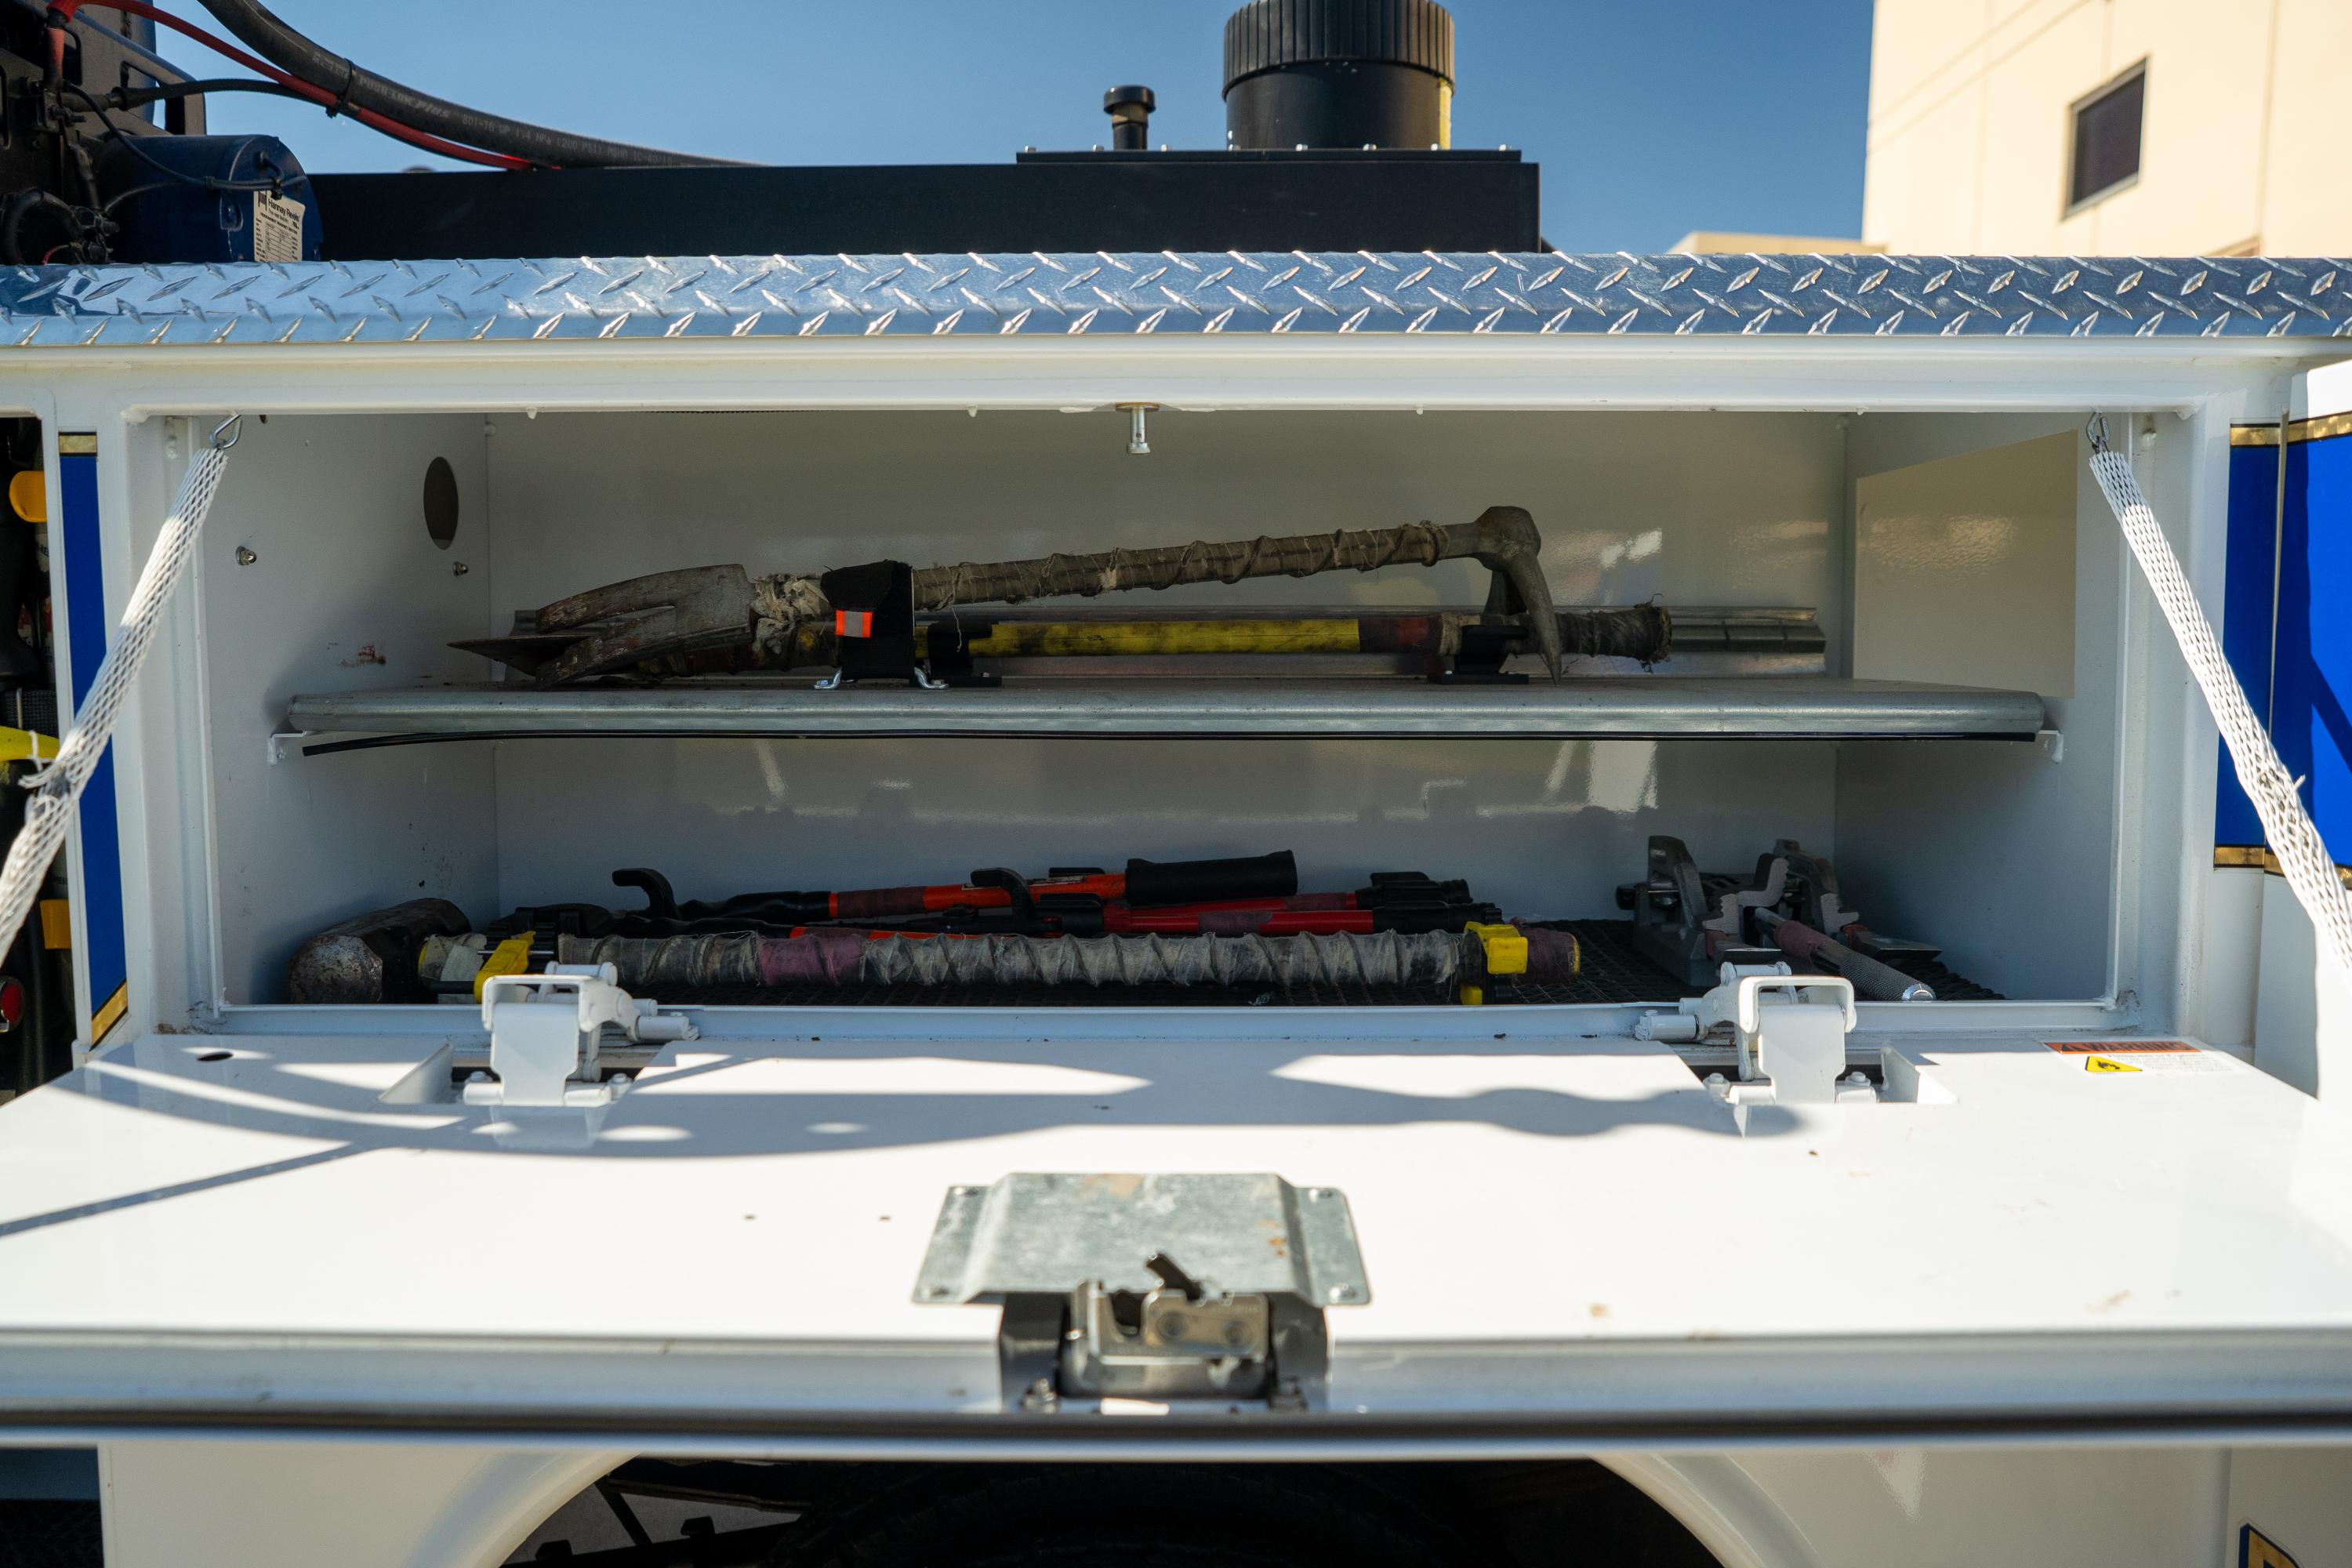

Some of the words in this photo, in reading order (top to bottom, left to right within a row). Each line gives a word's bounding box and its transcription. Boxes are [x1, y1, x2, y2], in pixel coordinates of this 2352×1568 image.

[268, 198, 285, 216] Hannay
[286, 208, 299, 222] Reels
[2082, 1042, 2192, 1051] WARNING
